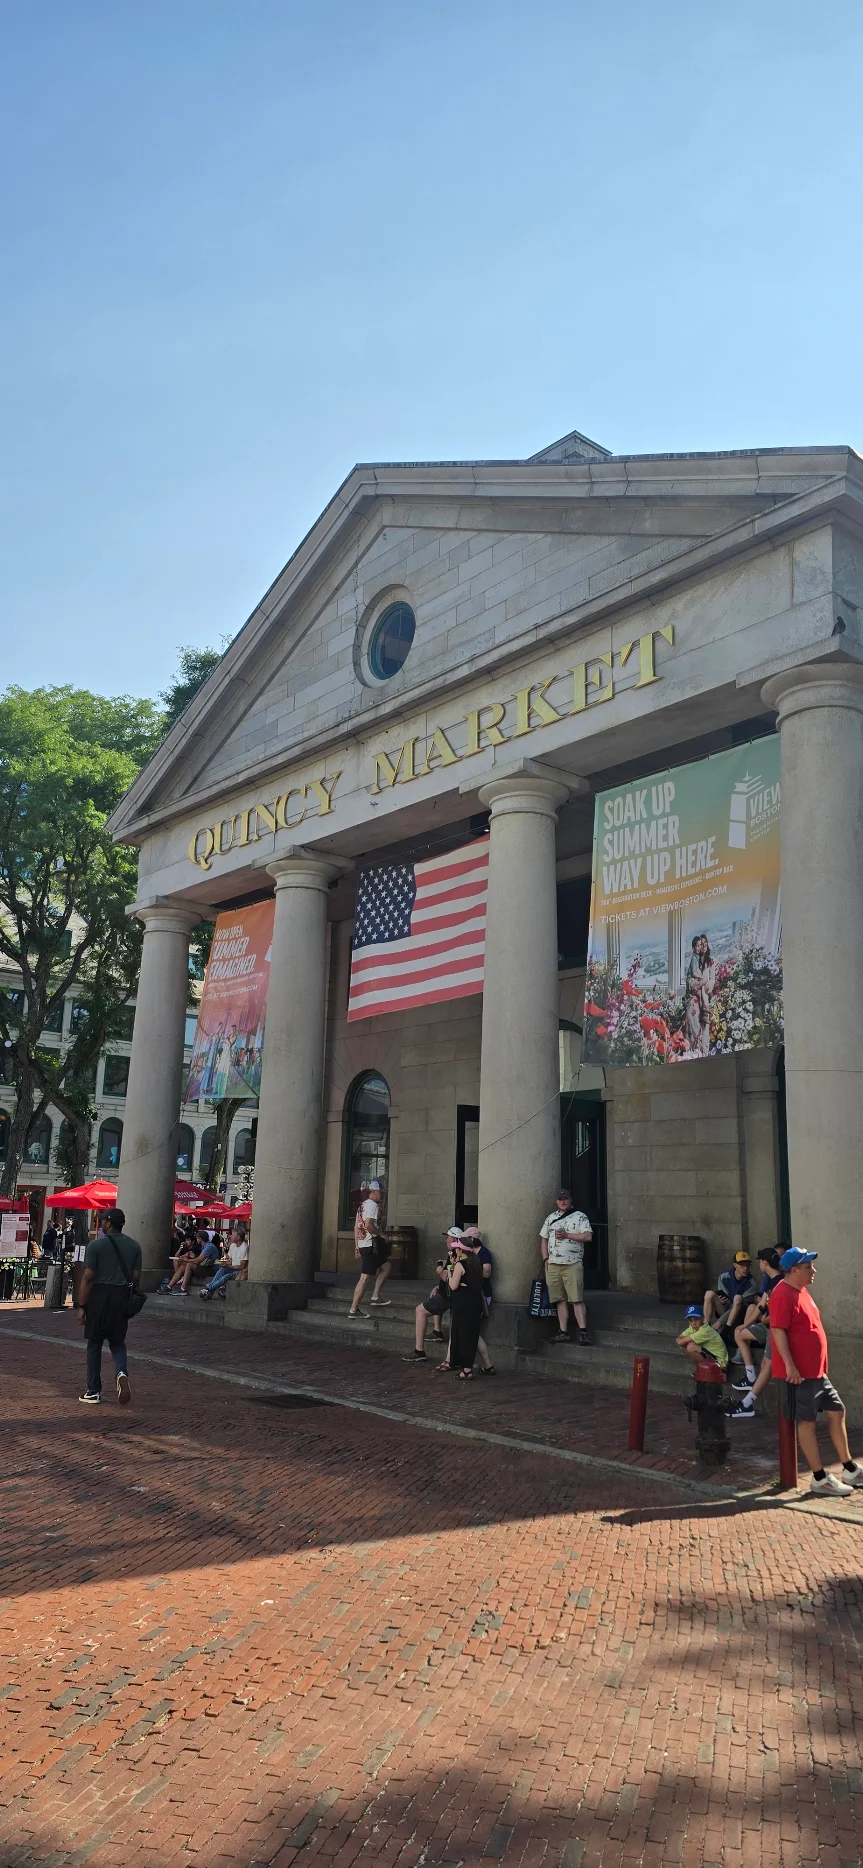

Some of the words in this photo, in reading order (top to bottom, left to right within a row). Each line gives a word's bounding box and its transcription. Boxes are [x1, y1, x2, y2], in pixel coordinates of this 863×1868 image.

[187, 770, 342, 871] QUINCY
[371, 624, 675, 795] MARKET
[603, 788, 648, 830] SOAK
[651, 781, 676, 816] UP
[602, 815, 681, 863] SUMMER
[602, 857, 643, 895] WAY
[646, 851, 671, 885] UP
[675, 835, 719, 879] HERE.
[600, 910, 637, 924] TICKETS
[639, 907, 651, 918] AT
[652, 884, 728, 915] VIEWBOSTON.COM
[208, 953, 257, 982] EIMAGINED.
